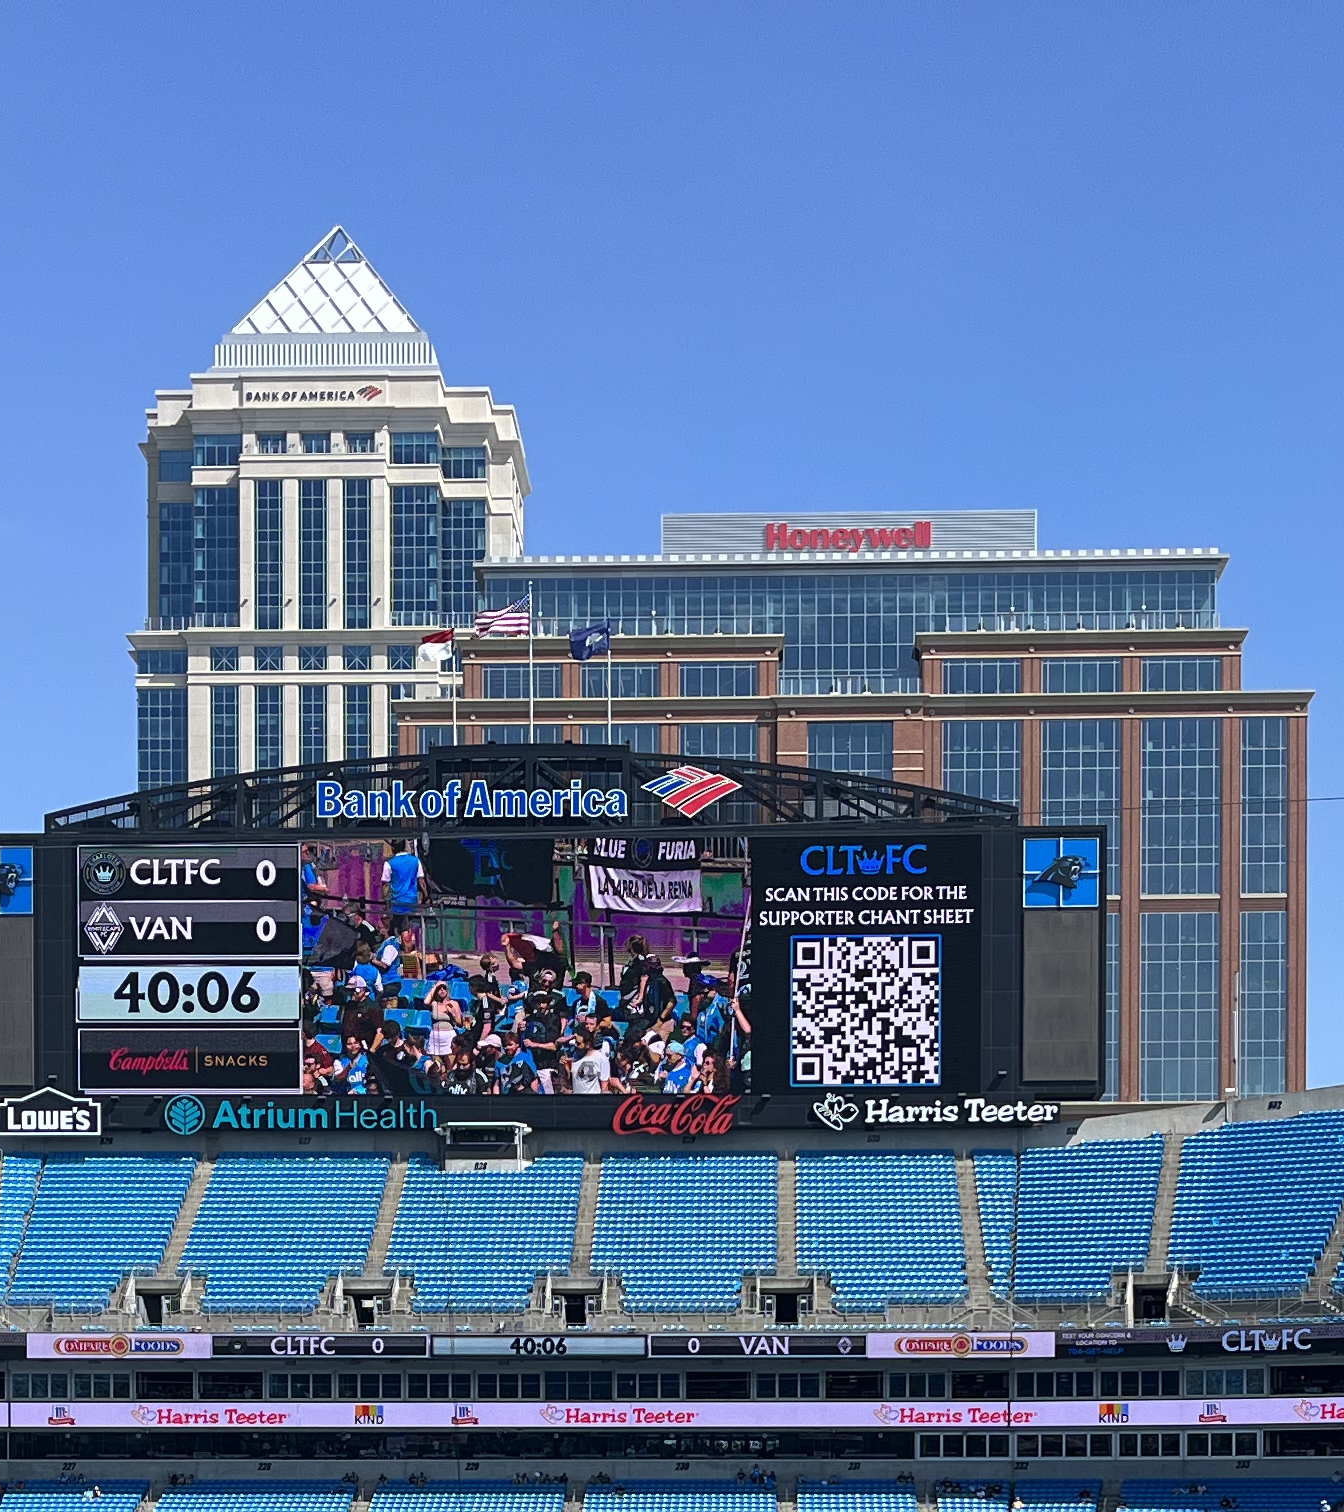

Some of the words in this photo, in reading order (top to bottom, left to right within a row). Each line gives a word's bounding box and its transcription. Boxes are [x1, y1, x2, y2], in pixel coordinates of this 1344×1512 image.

[246, 391, 279, 402] BANK
[281, 391, 297, 402] OF
[299, 390, 356, 401] AMERICA
[765, 521, 932, 553] Honeywell
[316, 779, 416, 818] Bank
[419, 779, 462, 818] of
[464, 779, 628, 818] America
[657, 839, 696, 861] FURIA
[129, 859, 221, 886] CLTFC
[256, 859, 276, 887] 0
[765, 887, 810, 902] SCAN
[813, 887, 848, 902] THIS
[852, 886, 898, 901] CODE
[901, 886, 933, 900] FOR
[937, 885, 968, 900] THE
[759, 910, 855, 926] SUPPORTER
[858, 909, 920, 925] CHANT
[924, 908, 974, 924] SHEET
[129, 917, 193, 940] VAN
[256, 915, 277, 942] 0
[113, 971, 260, 1013] 40:06
[204, 1055, 269, 1067] SNACKS
[212, 1100, 328, 1129] Atrium
[335, 1100, 438, 1129] Health
[864, 1099, 958, 1123] Harris
[963, 1099, 1058, 1122] Teeter
[270, 1337, 336, 1355] CLTFC
[372, 1338, 384, 1354] 0
[509, 1337, 568, 1356] 40:06
[688, 1338, 699, 1354] 0
[738, 1337, 789, 1355] VAN
[156, 1408, 219, 1425] Harris
[225, 1408, 287, 1425] Teeter
[355, 1414, 384, 1425] KIND
[564, 1408, 627, 1424] Harris
[632, 1408, 695, 1424] Teeter
[899, 1407, 963, 1424] Harris
[968, 1407, 1034, 1424] Teeter
[1099, 1413, 1129, 1424] KIND
